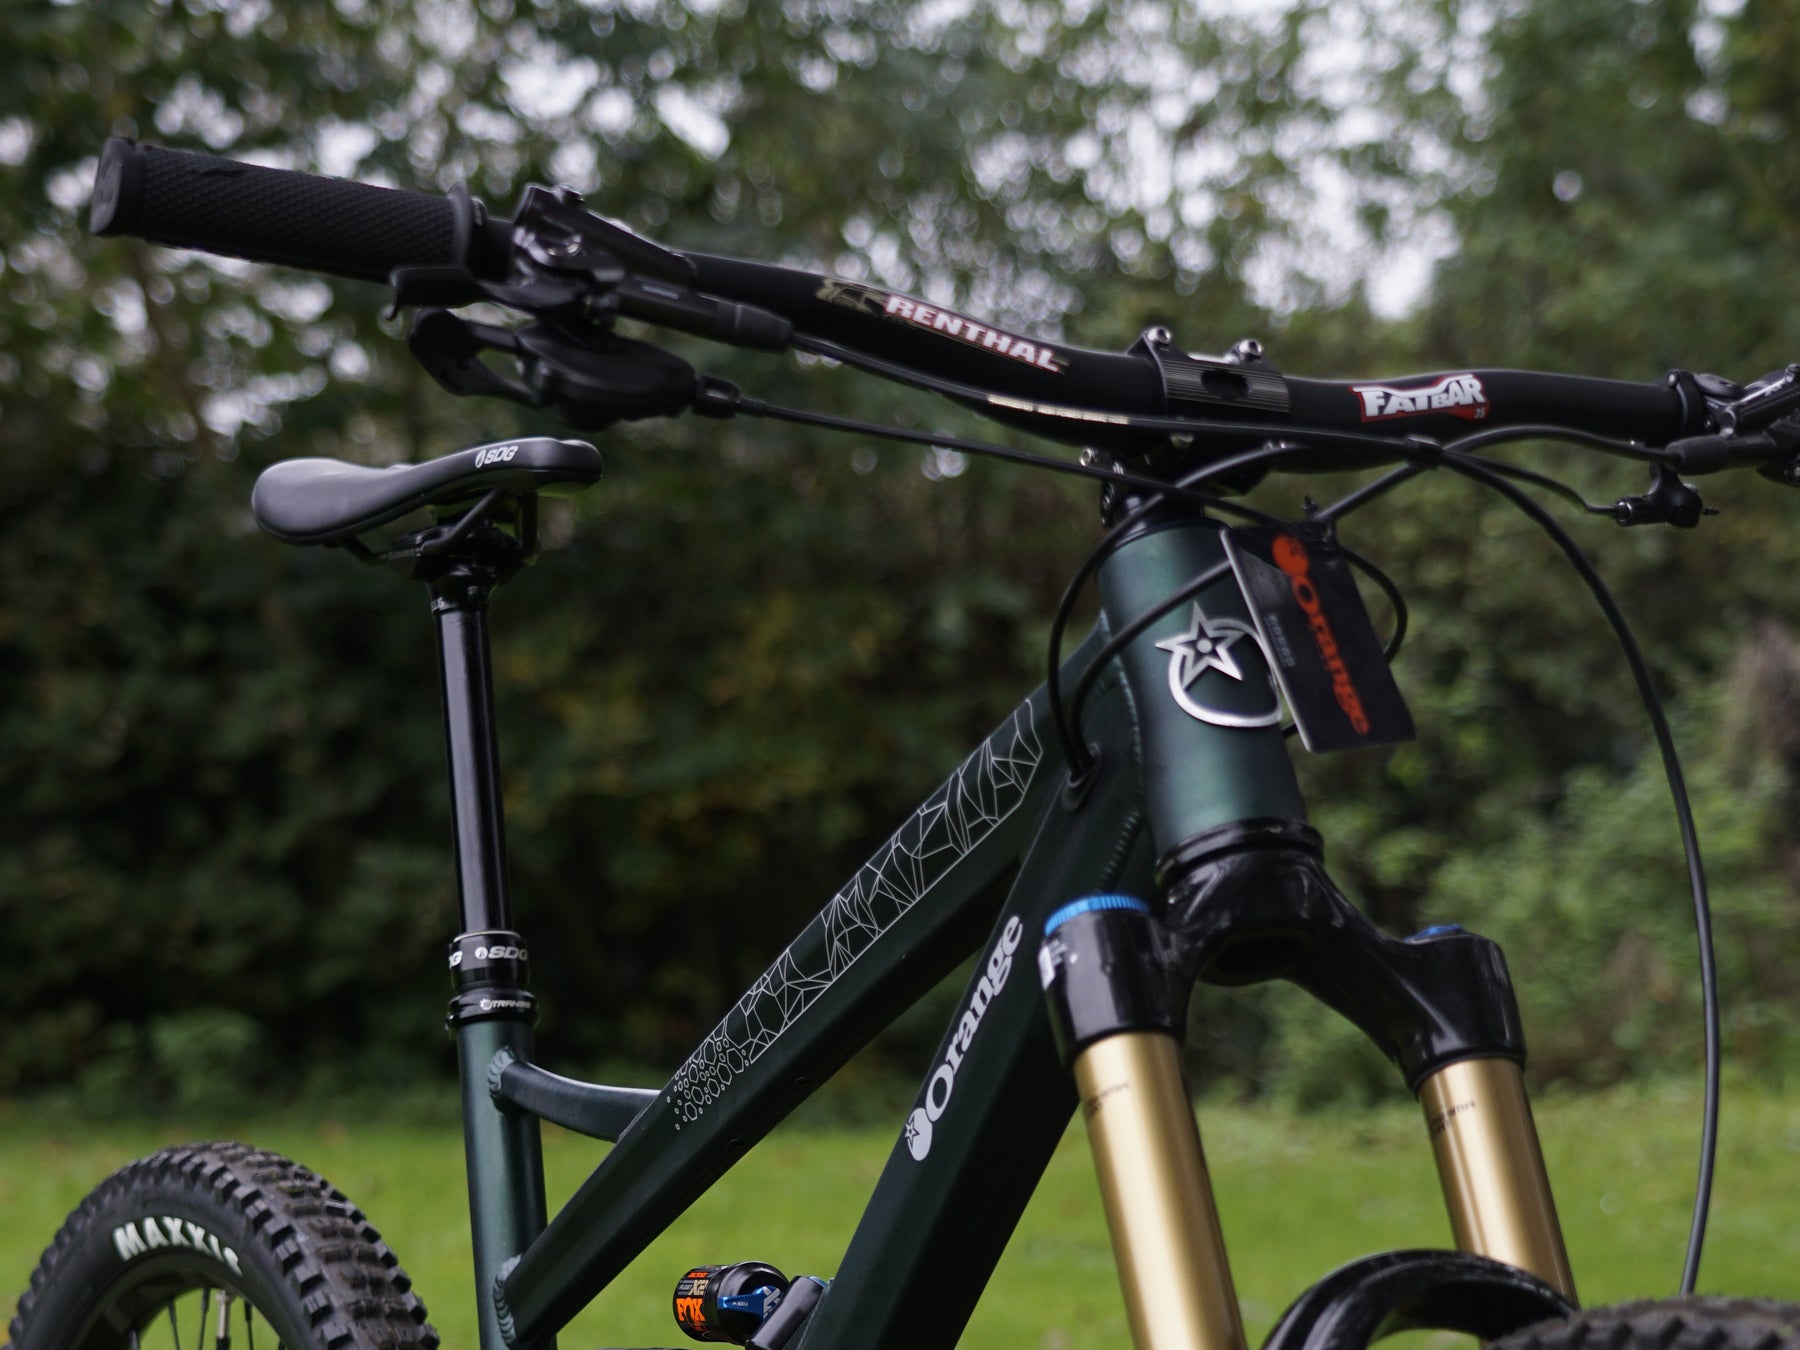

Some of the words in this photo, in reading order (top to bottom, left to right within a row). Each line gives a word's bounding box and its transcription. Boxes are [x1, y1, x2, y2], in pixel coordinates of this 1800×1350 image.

[884, 295, 1060, 373] RENTHAL
[1351, 373, 1487, 418] FATBAR
[1473, 407, 1487, 419] 35
[484, 445, 519, 465] SDG
[487, 945, 528, 961] SDG
[925, 915, 1024, 1123] Orange
[688, 1279, 709, 1296] X2
[675, 1297, 707, 1324] FOX
